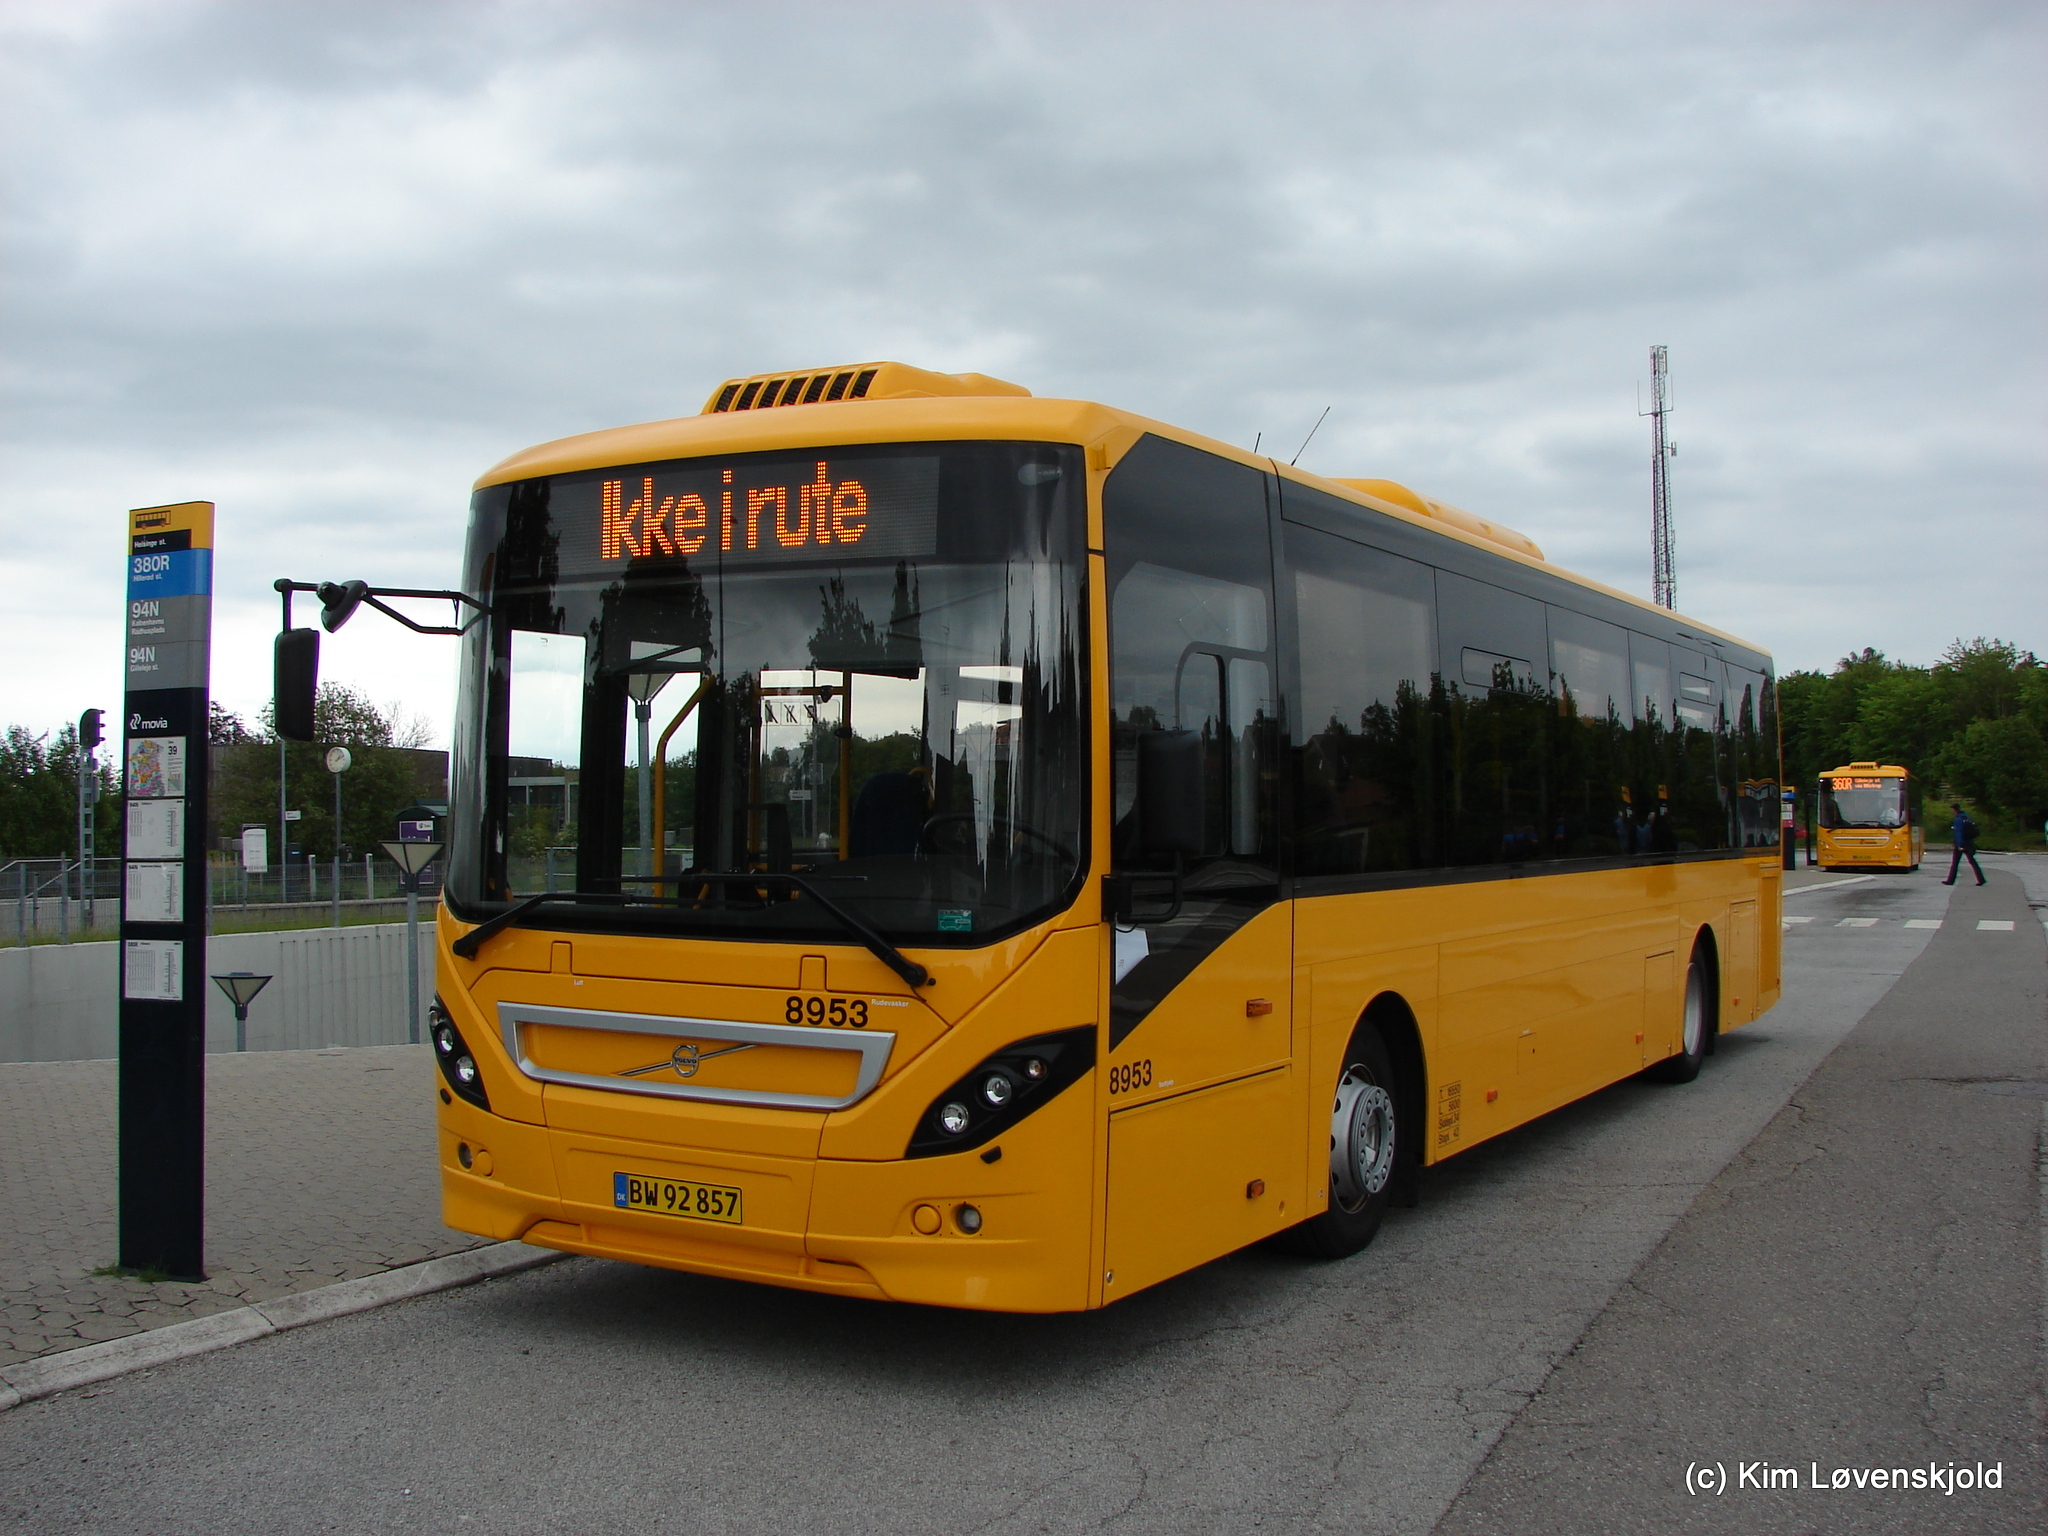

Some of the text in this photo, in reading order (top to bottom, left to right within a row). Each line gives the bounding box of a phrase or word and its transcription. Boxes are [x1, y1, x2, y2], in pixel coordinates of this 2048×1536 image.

[602, 461, 867, 559] Ikke i rute
[134, 555, 170, 574] 380R
[132, 601, 159, 618] 94N
[130, 646, 156, 664] 94N
[141, 717, 168, 729] movia
[168, 745, 177, 755] 39
[1832, 777, 1853, 790] 360R
[786, 996, 868, 1028] 8953
[1110, 1059, 1152, 1094] 8953
[616, 1193, 625, 1201] DK
[630, 1179, 738, 1216] BW 92 857
